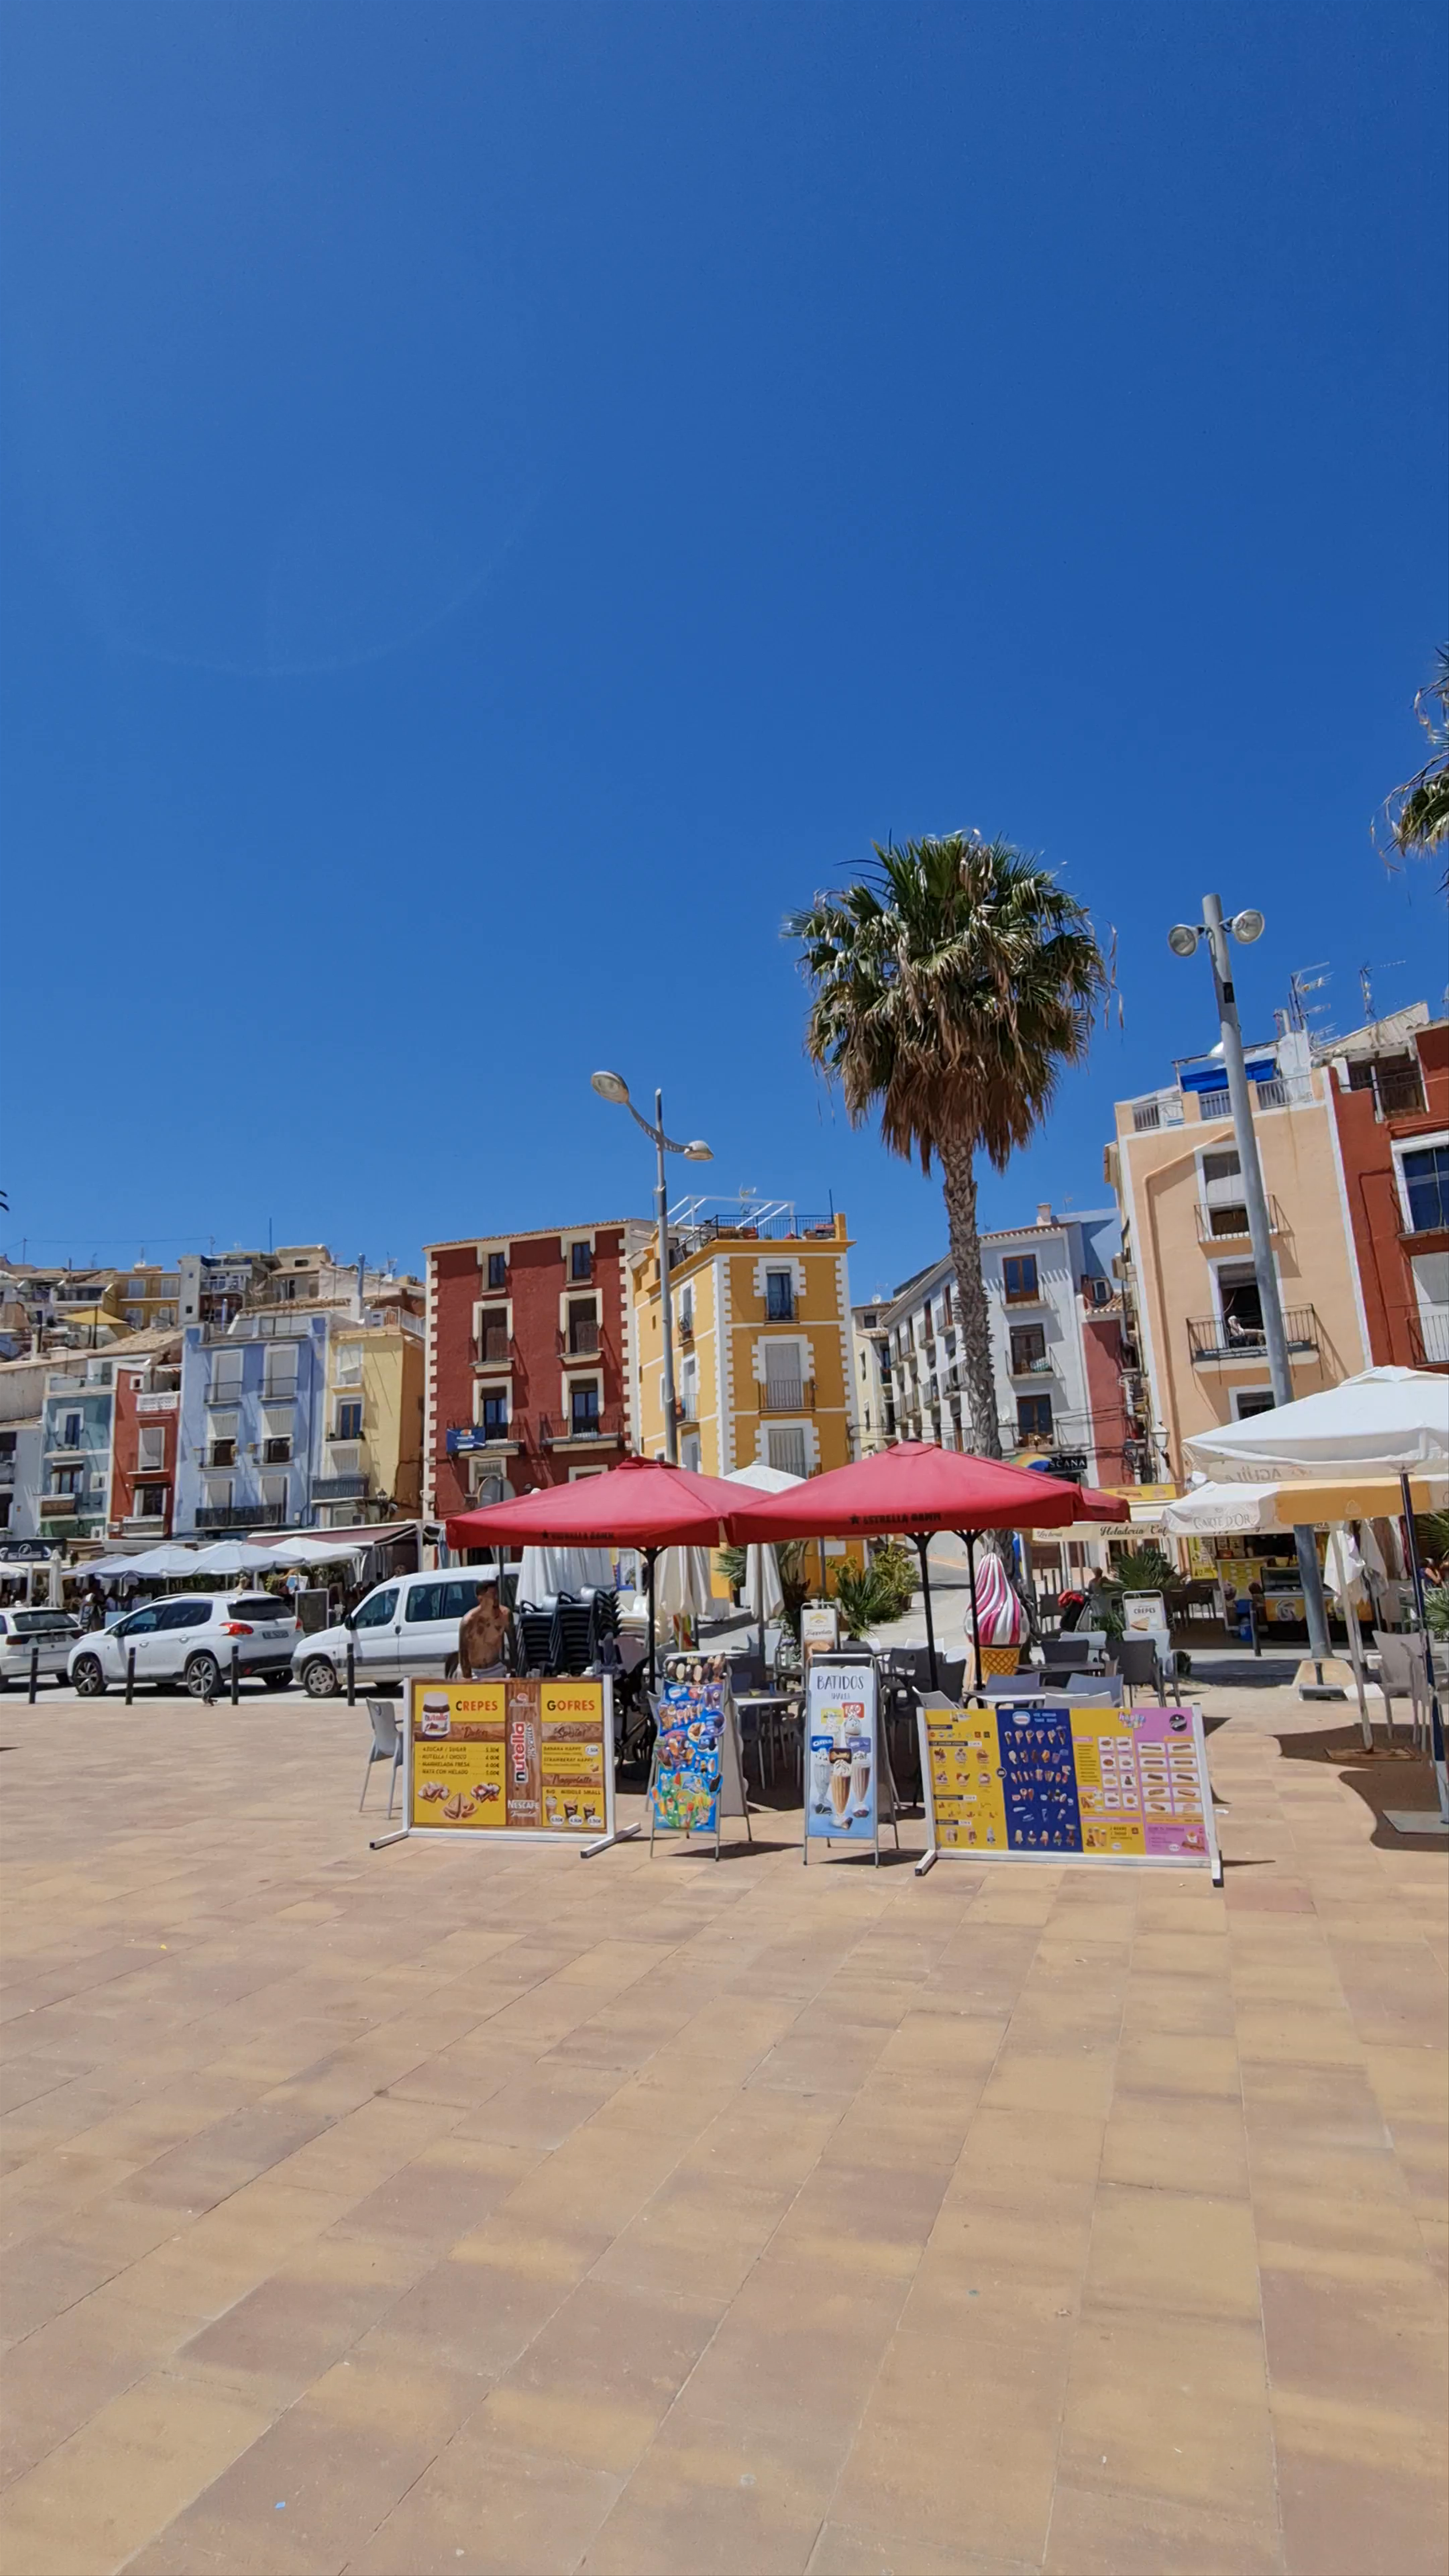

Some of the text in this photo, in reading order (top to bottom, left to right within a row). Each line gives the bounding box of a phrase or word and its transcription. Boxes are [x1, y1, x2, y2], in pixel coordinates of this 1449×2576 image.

[817, 1675, 864, 1690] BATIDOS
[456, 1701, 498, 1711] CREPES
[547, 1700, 595, 1711] GOFRES
[511, 1722, 525, 1782] nutella
